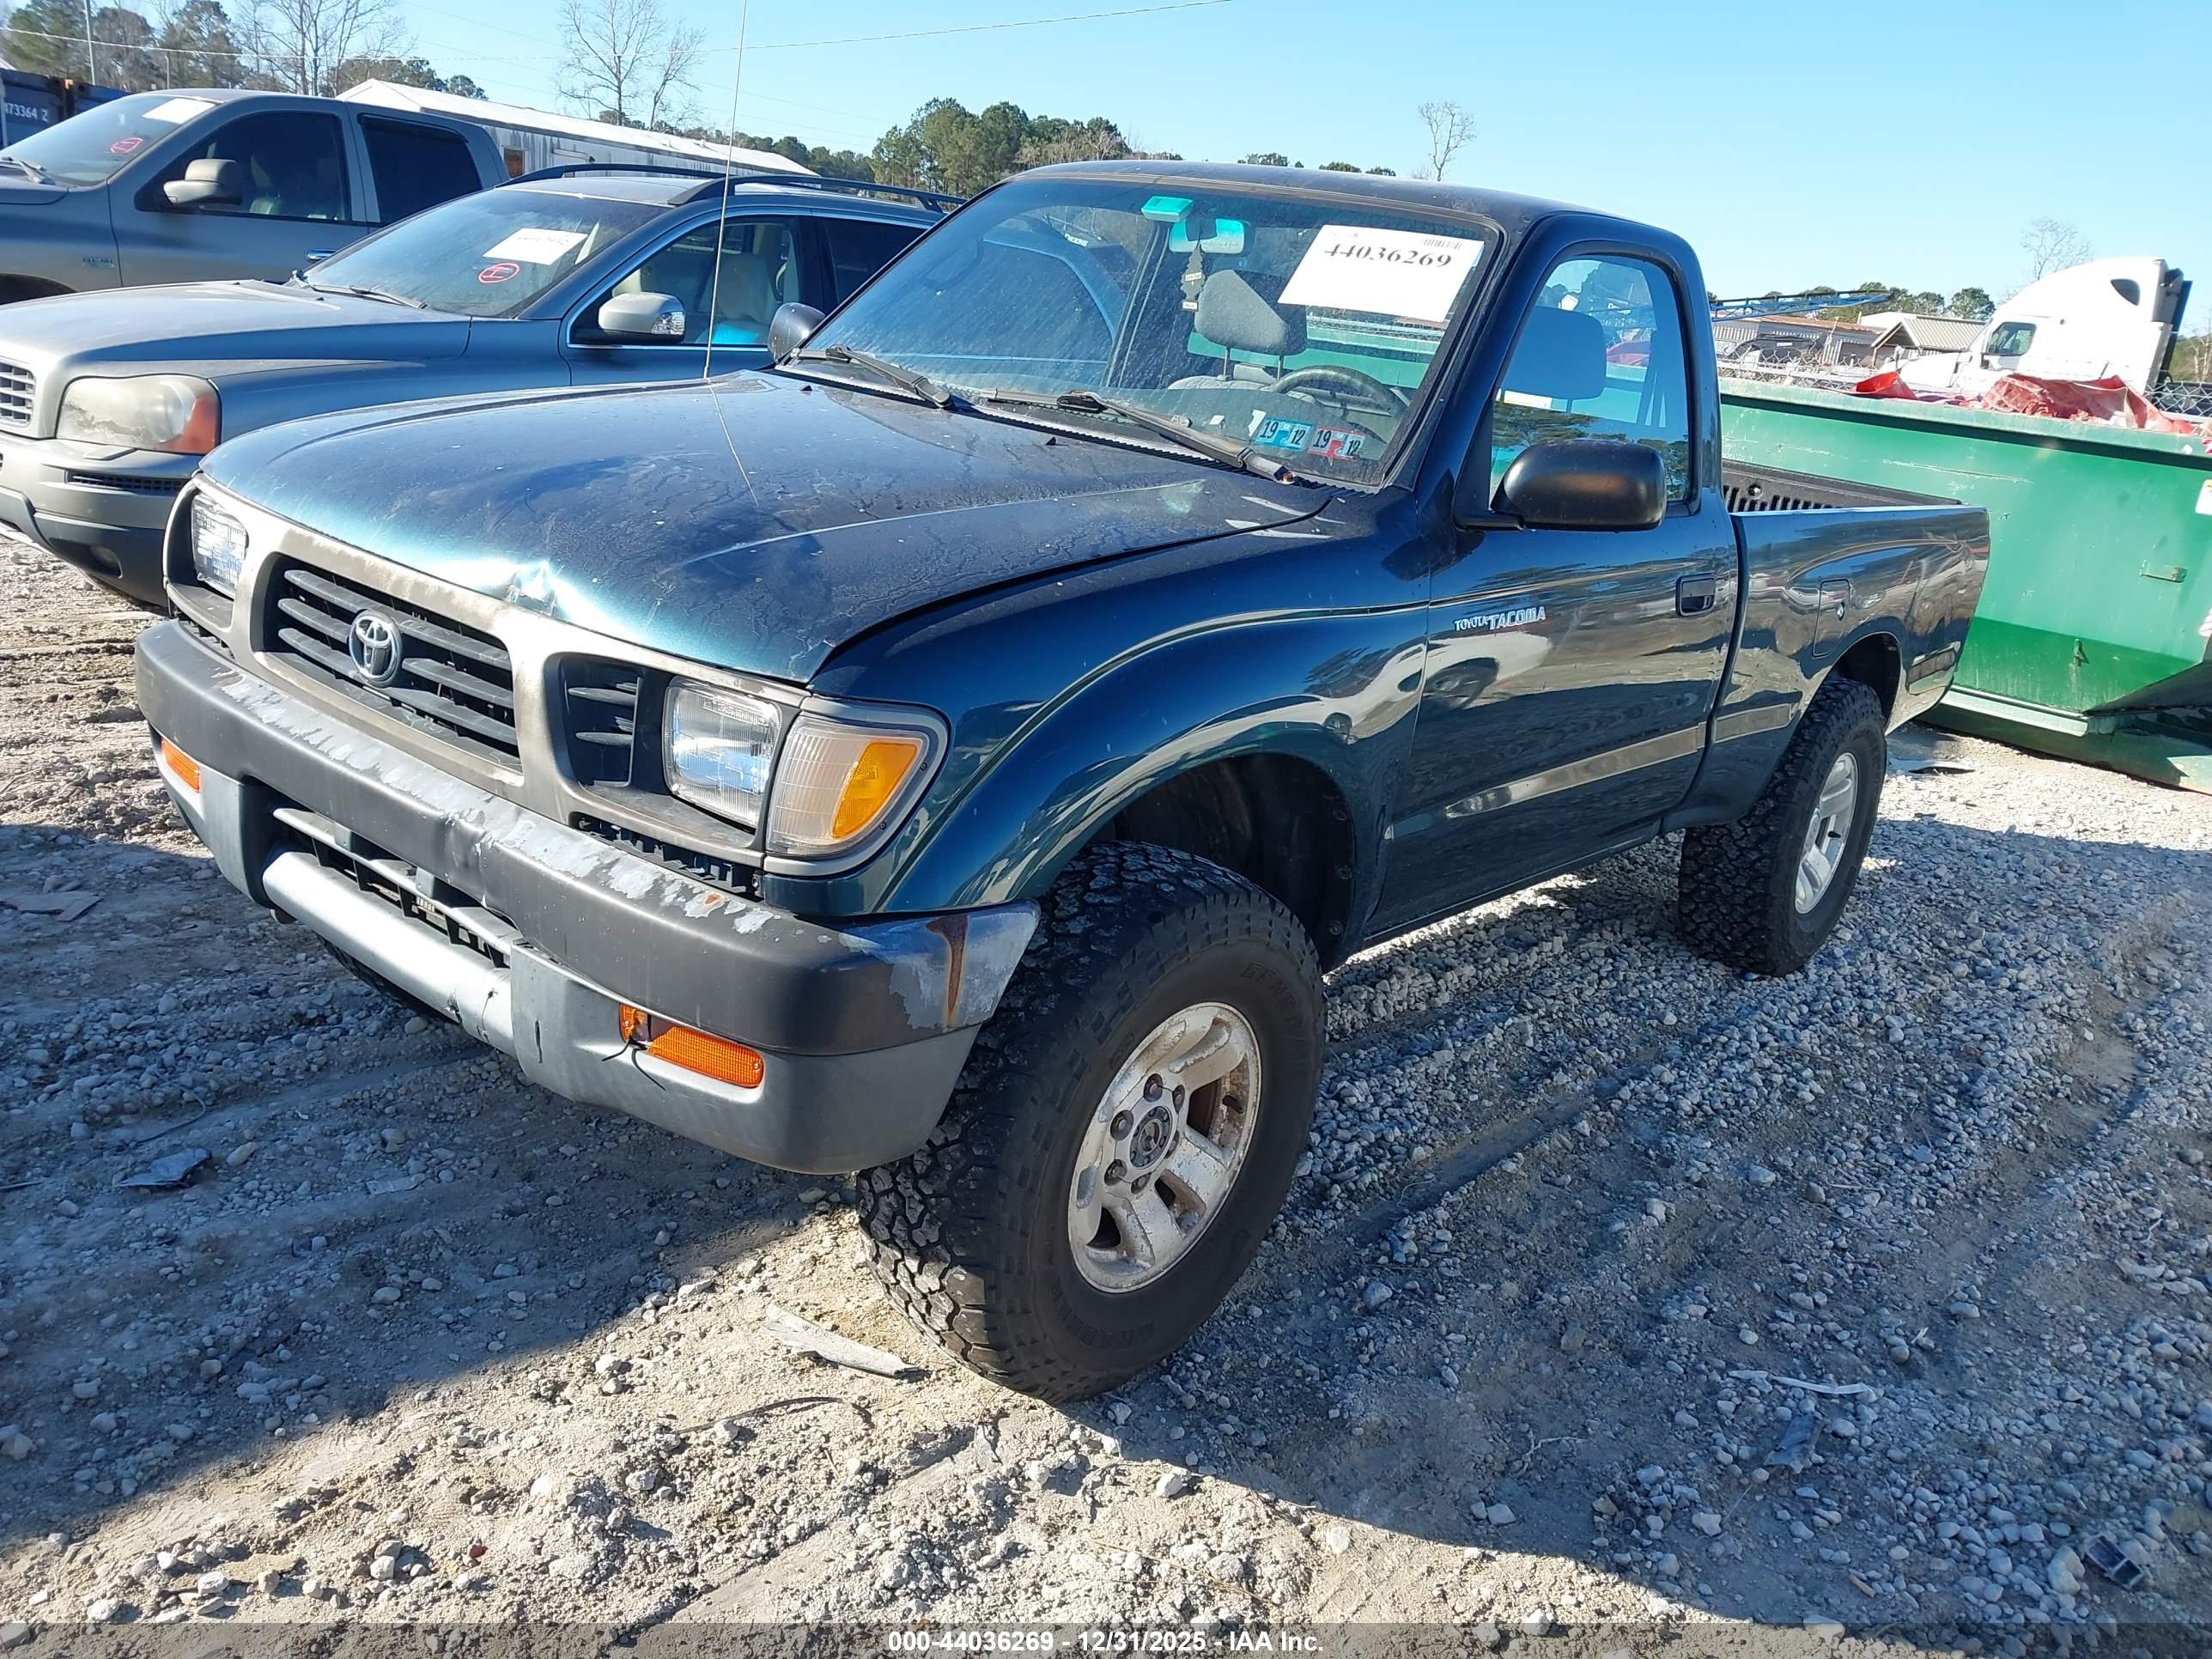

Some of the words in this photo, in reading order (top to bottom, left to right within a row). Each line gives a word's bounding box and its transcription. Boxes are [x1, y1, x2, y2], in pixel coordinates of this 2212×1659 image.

[1325, 244, 1452, 268] 44036269
[1260, 422, 1279, 439] 19
[1291, 428, 1306, 445] 12
[1313, 429, 1332, 447] 19
[1346, 439, 1361, 456] 12
[1455, 615, 1489, 631] TOYOTA
[1488, 606, 1547, 630] TACOMA
